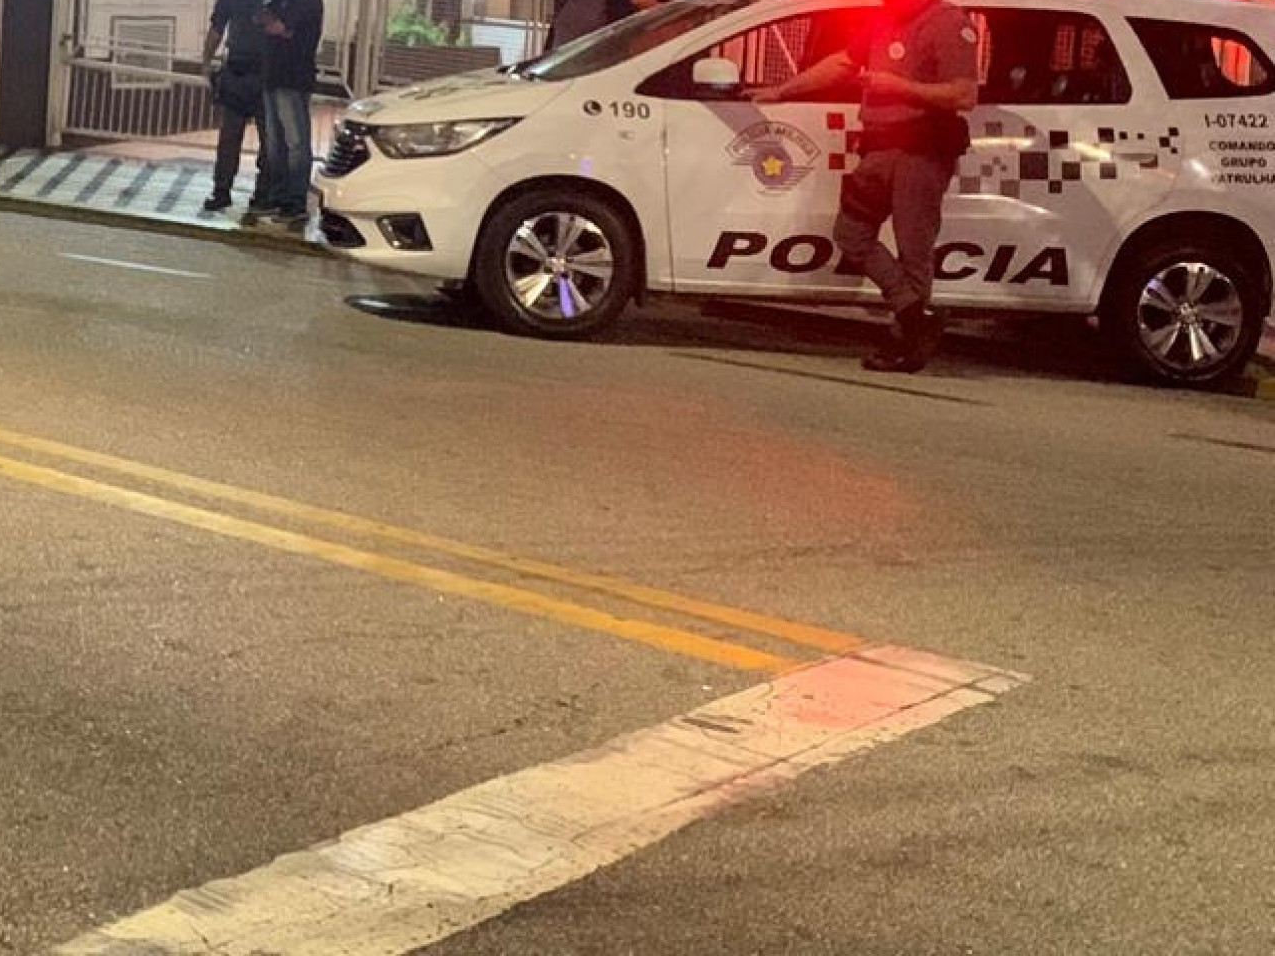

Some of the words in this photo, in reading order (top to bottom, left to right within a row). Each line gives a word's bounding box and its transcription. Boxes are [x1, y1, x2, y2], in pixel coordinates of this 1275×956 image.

[608, 100, 651, 120] 190
[1221, 157, 1267, 168] GRUPO
[707, 231, 1069, 285] POCIA
